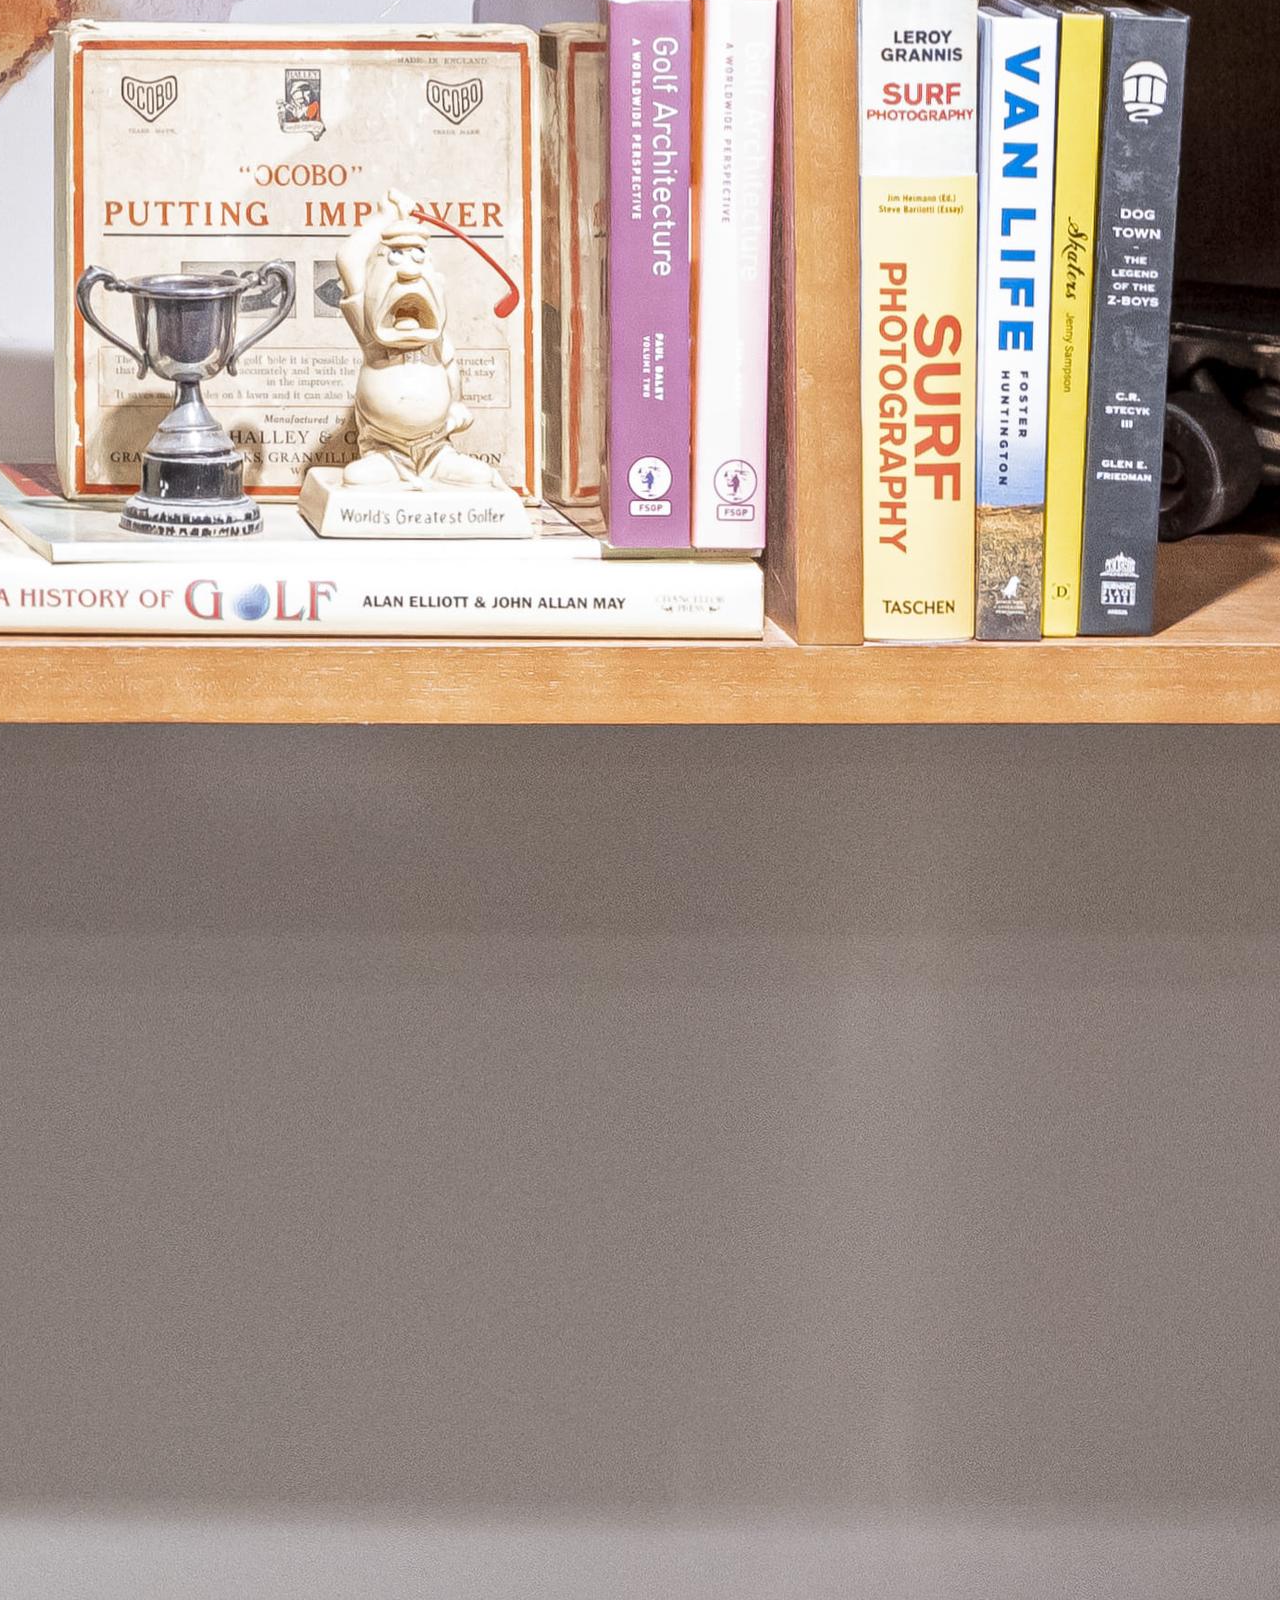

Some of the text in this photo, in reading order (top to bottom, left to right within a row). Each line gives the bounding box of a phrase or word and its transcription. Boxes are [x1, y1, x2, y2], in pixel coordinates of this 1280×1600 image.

[893, 30, 952, 44] LEROY
[881, 48, 963, 62] GRANNIS
[126, 80, 175, 115] OCOBO
[431, 83, 479, 119] OCOBO
[882, 82, 962, 106] SURF
[866, 109, 974, 122] PHOTOGRAPHY
[631, 38, 642, 221] A WORLDWIDE PERSPECTIVE
[721, 42, 735, 224] A WORLDWIDE PERSPECTIVE
[651, 36, 679, 277] Golf Architecture
[887, 194, 900, 202] Jim
[998, 46, 1041, 352] VAN LIFE
[104, 200, 504, 228] PUTTING IMPVER
[878, 205, 901, 213] Steve
[936, 205, 964, 215] (Essay)
[1120, 208, 1156, 221] DOG
[1112, 226, 1161, 240] TOWN
[1061, 215, 1089, 301] Skaters
[1124, 255, 1147, 265] THE
[1111, 270, 1158, 279] LEGEND
[1113, 282, 1155, 292] OF THE
[1107, 295, 1160, 308] Z-BOYS
[654, 332, 665, 362] PAUL
[1062, 312, 1074, 394] Jenny Sampson
[115, 354, 362, 367] The golf hole it is possible to
[642, 335, 651, 398] VOLUME TWO
[115, 366, 495, 379] that accurately and with the stay
[267, 377, 344, 388] in the improver.
[222, 391, 234, 400] on
[246, 389, 269, 400] lawn
[272, 389, 290, 400] and
[293, 389, 301, 400] it
[304, 391, 321, 400] can
[324, 389, 343, 400] also
[1115, 392, 1141, 402] C.R.
[878, 262, 908, 554] PHOTOGRAPHY
[914, 312, 962, 501] SURF
[1017, 369, 1029, 438] FOSTER
[1104, 406, 1151, 416] STECYK
[264, 414, 346, 426] Manufactured by
[1120, 419, 1133, 429] III
[998, 369, 1010, 487] HUNTINGTON
[230, 430, 309, 445] HALLEY
[319, 430, 332, 445] &
[268, 452, 361, 463] GRANVILLE
[1101, 460, 1148, 470] GLEN E.
[1096, 471, 1153, 482] FRIEDMAN
[340, 507, 506, 525] World's Greatest Golfer
[20, 588, 130, 608] HISTORY
[139, 589, 175, 608] OF
[1056, 585, 1068, 598] D
[362, 595, 627, 610] ALAN ELLIOTT & JOHN ALLAN MAY
[882, 599, 956, 615] TASCHEN
